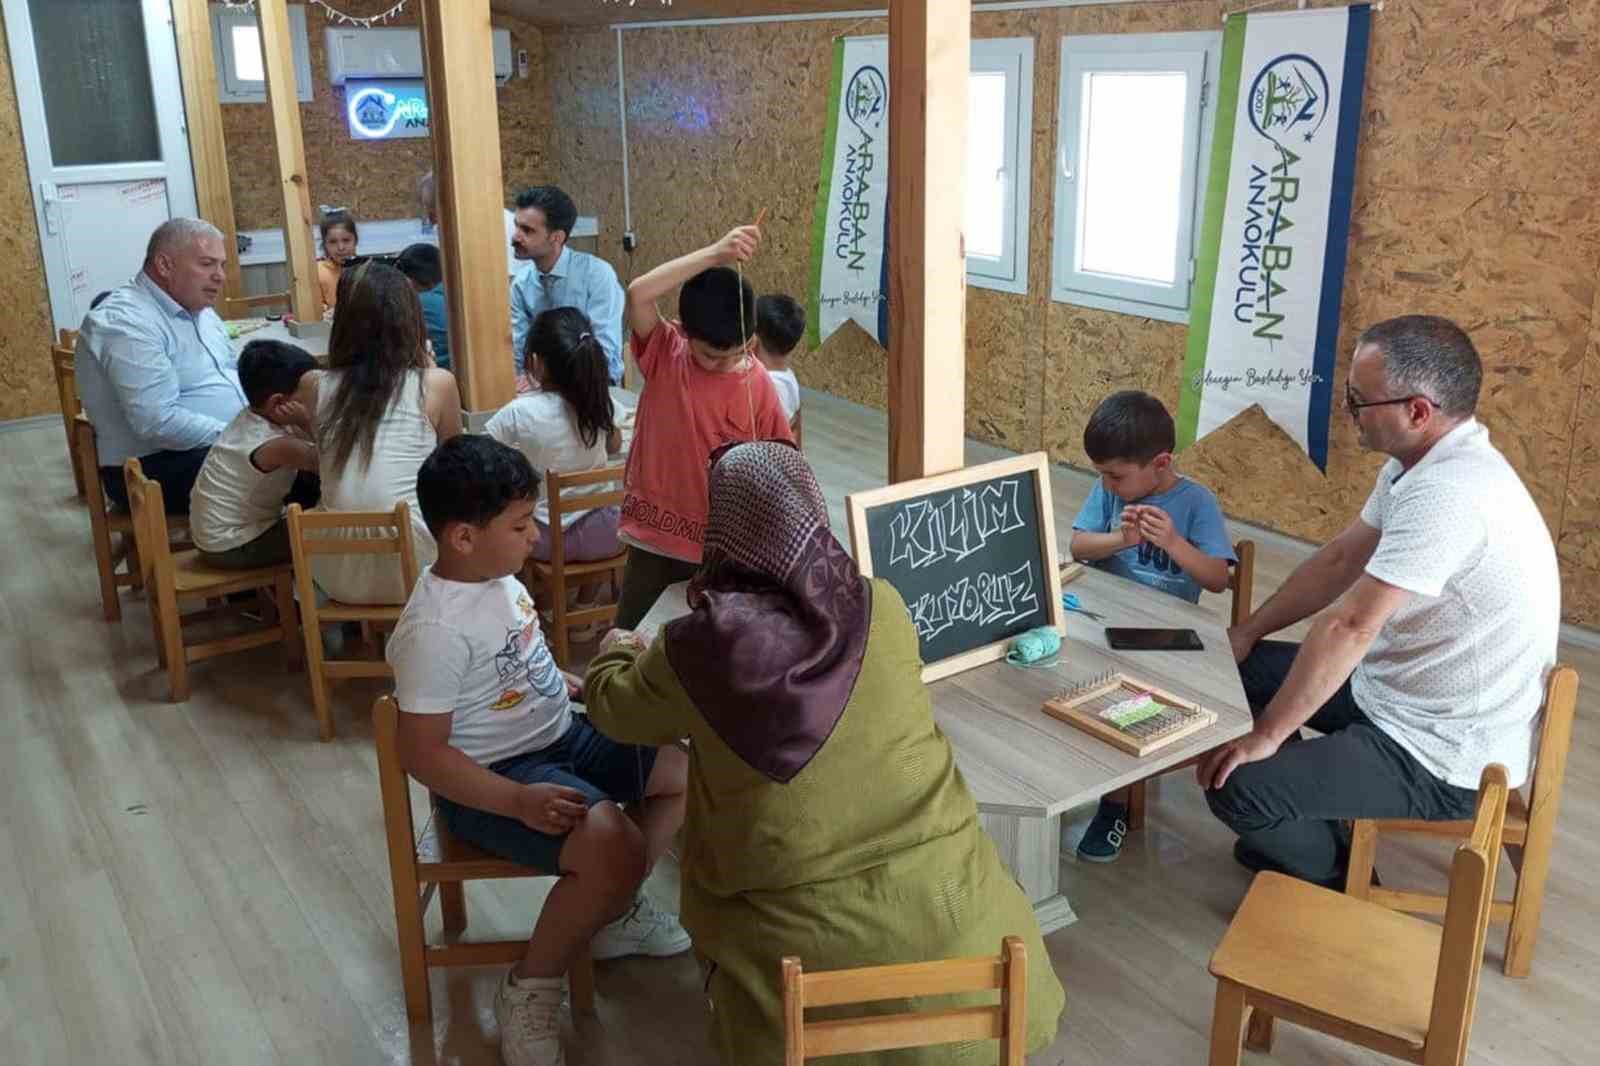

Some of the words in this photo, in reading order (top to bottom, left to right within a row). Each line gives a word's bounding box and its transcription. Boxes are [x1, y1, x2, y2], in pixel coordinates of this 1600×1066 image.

[836, 144, 857, 259] ANAOKULU
[847, 133, 873, 270] ARABAN
[1234, 164, 1267, 323] ANAOKULU
[1253, 148, 1301, 341] ARABAN
